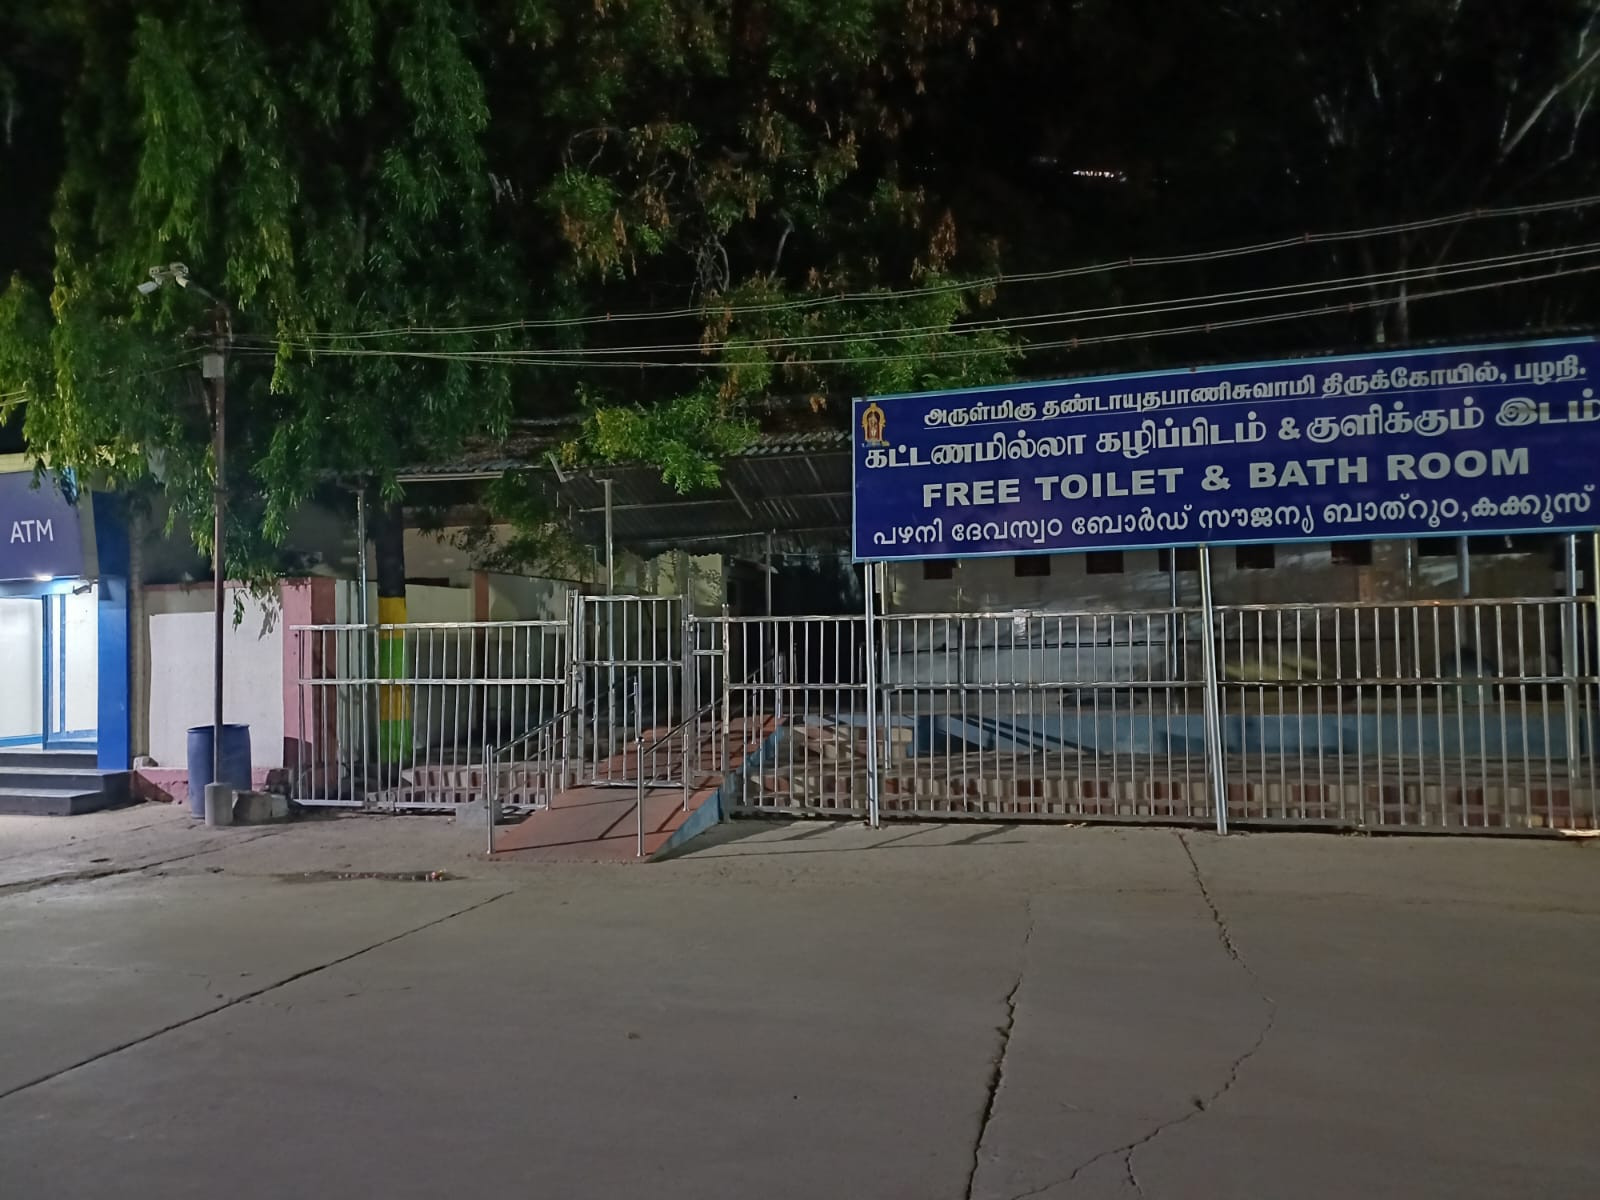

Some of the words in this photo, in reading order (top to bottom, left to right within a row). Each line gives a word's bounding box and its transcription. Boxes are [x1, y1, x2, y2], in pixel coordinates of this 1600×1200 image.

[923, 399, 1038, 427] அருள்மிகு
[1042, 374, 1315, 421] தண்டாயுதபாணிசுவாமி
[1321, 361, 1507, 399] திருக்கோயில்,
[1514, 354, 1587, 385] பழநி.
[864, 431, 1088, 470] கட்டணமில்லா
[1095, 411, 1267, 460] கழிப்பிடம்
[1278, 416, 1301, 441] &
[1306, 396, 1485, 443] குளிக்கும்
[1495, 387, 1600, 427] இடம்
[923, 478, 1022, 508] FREE
[1034, 467, 1185, 502] TOILET
[1201, 465, 1231, 491] &
[1249, 456, 1369, 489] BATH
[1387, 447, 1530, 482] ROOM
[10, 519, 55, 545] ATM
[873, 517, 944, 545] പഴനി
[951, 518, 1064, 544] ദേവസ്വം
